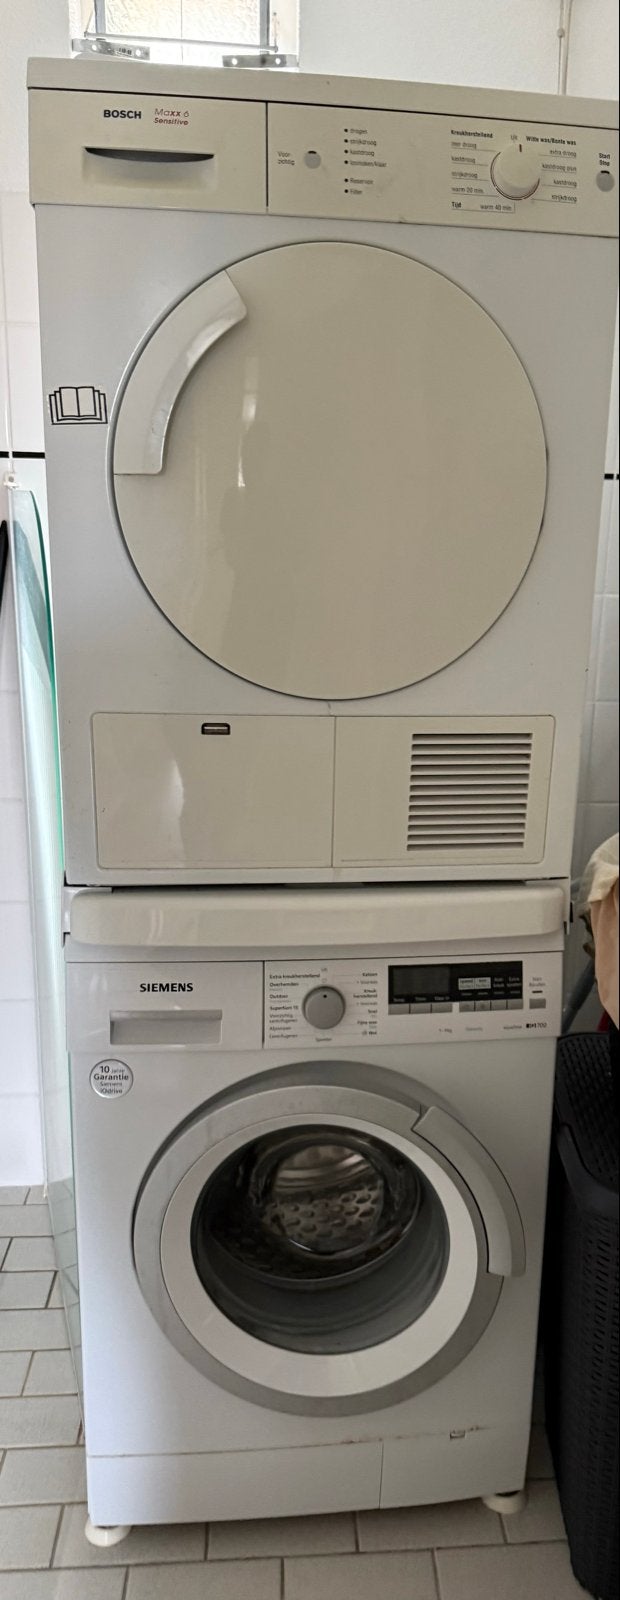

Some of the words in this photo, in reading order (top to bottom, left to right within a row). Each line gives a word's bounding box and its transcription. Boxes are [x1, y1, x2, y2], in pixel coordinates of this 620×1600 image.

[103, 109, 142, 119] BOSCH
[154, 108, 181, 117] Maxx
[154, 117, 189, 126] Sensitive
[450, 129, 493, 138] Kreukherstellend
[540, 137, 566, 145] was/Bonte
[562, 150, 577, 158] droog
[451, 155, 476, 164] kastdroog
[542, 163, 566, 171] kastdroog
[451, 171, 478, 179] strijkdroog
[553, 179, 577, 188] kastdroog
[551, 194, 577, 202] strijkdroog
[139, 982, 194, 993] SIEMENS
[100, 1065, 110, 1073] 10
[93, 1073, 129, 1081] Garantie
